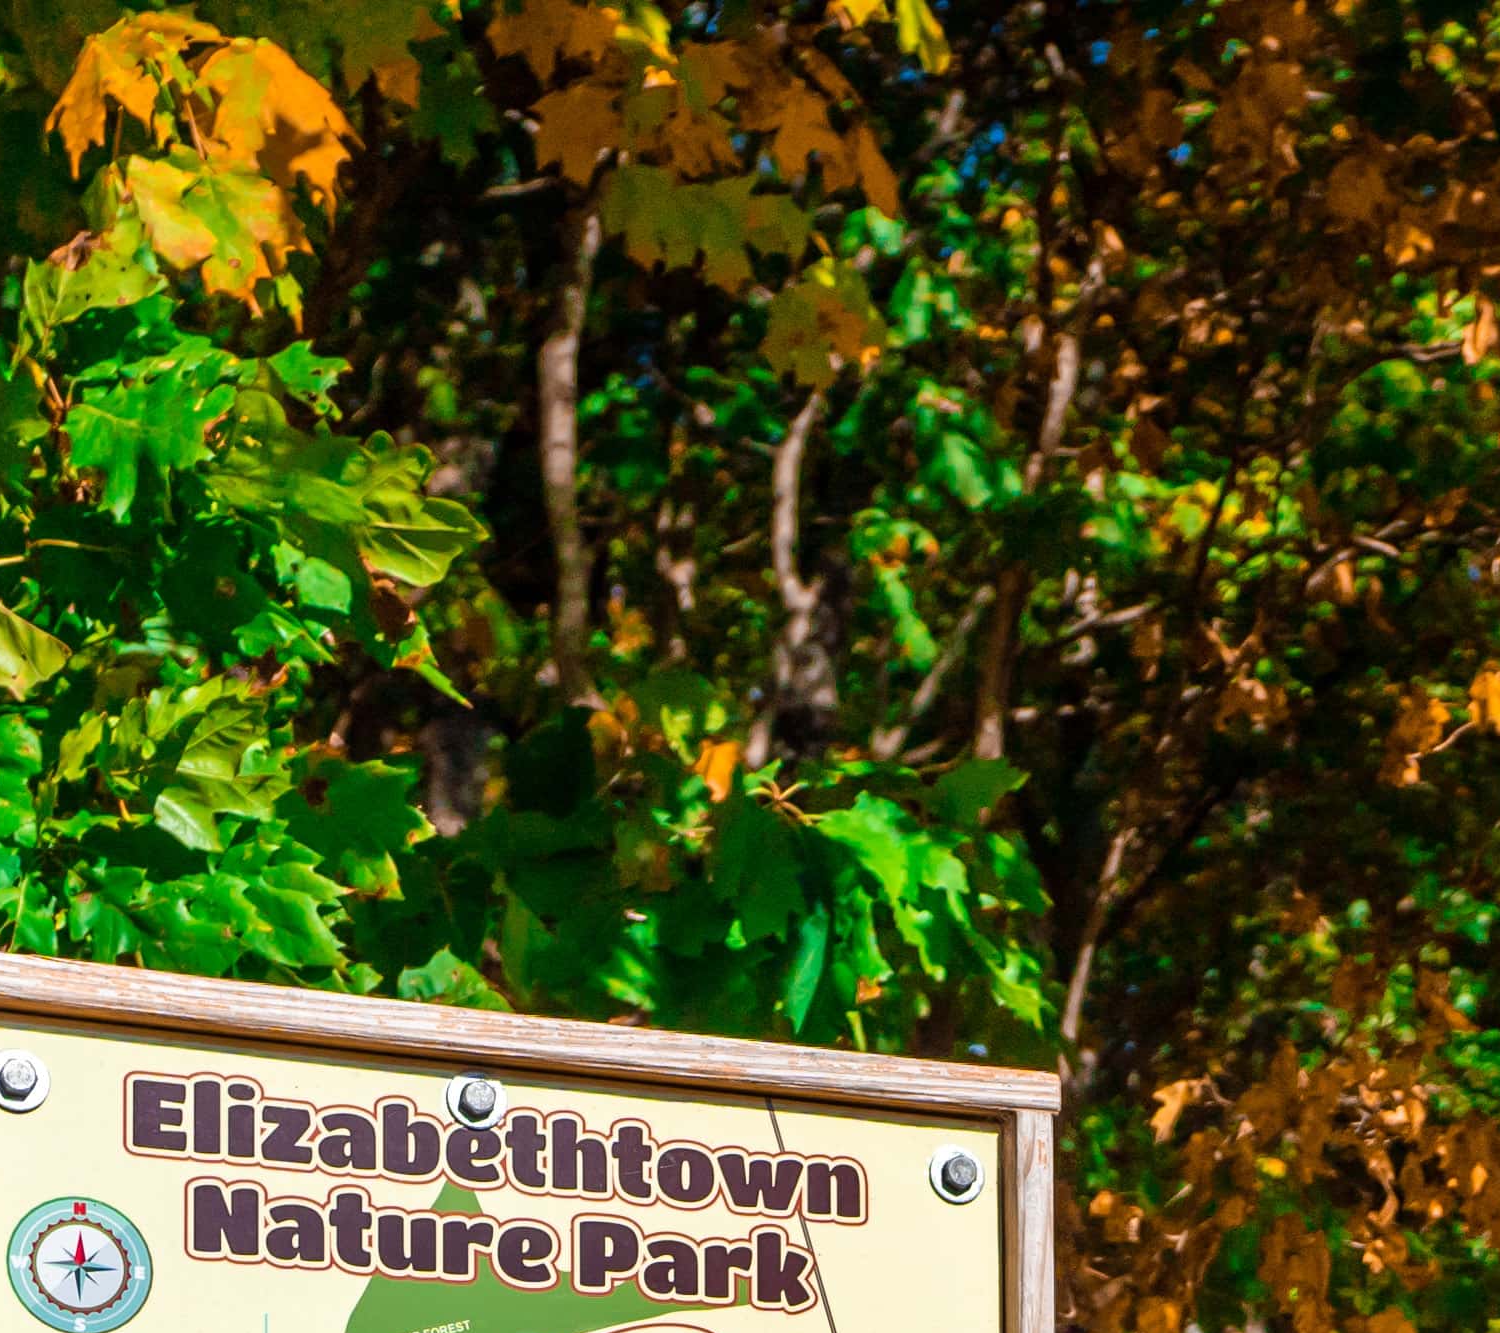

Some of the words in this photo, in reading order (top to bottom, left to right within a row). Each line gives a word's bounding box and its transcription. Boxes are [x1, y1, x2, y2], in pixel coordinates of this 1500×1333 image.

[127, 1074, 864, 1222] Elizabethtown
[73, 1202, 87, 1215] N
[188, 1180, 557, 1288] Nature
[575, 1217, 813, 1310] Park
[10, 1256, 28, 1269] W
[134, 1266, 146, 1280] E
[73, 1318, 87, 1332] S
